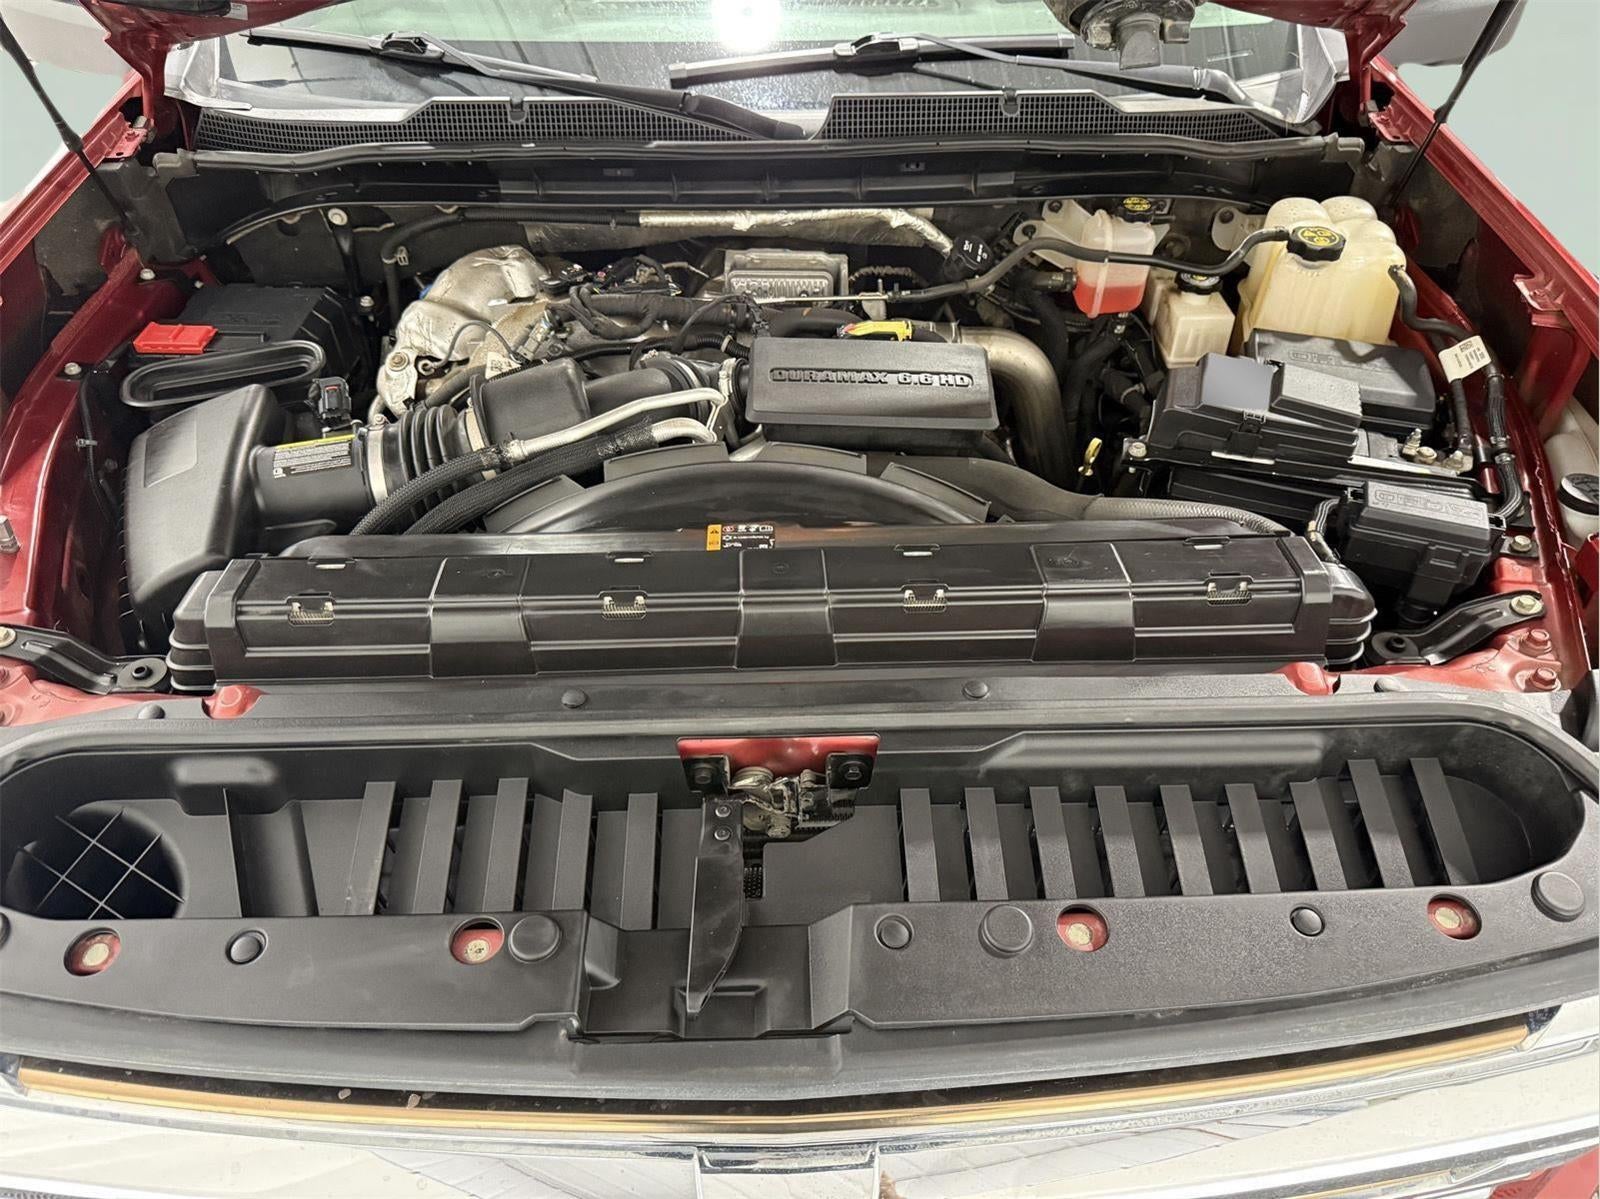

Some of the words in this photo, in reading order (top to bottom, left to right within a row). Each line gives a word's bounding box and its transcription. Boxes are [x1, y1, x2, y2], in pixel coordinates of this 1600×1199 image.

[771, 369, 887, 384] DURAMAX
[897, 372, 931, 385] 6.6
[939, 375, 971, 387] HD
